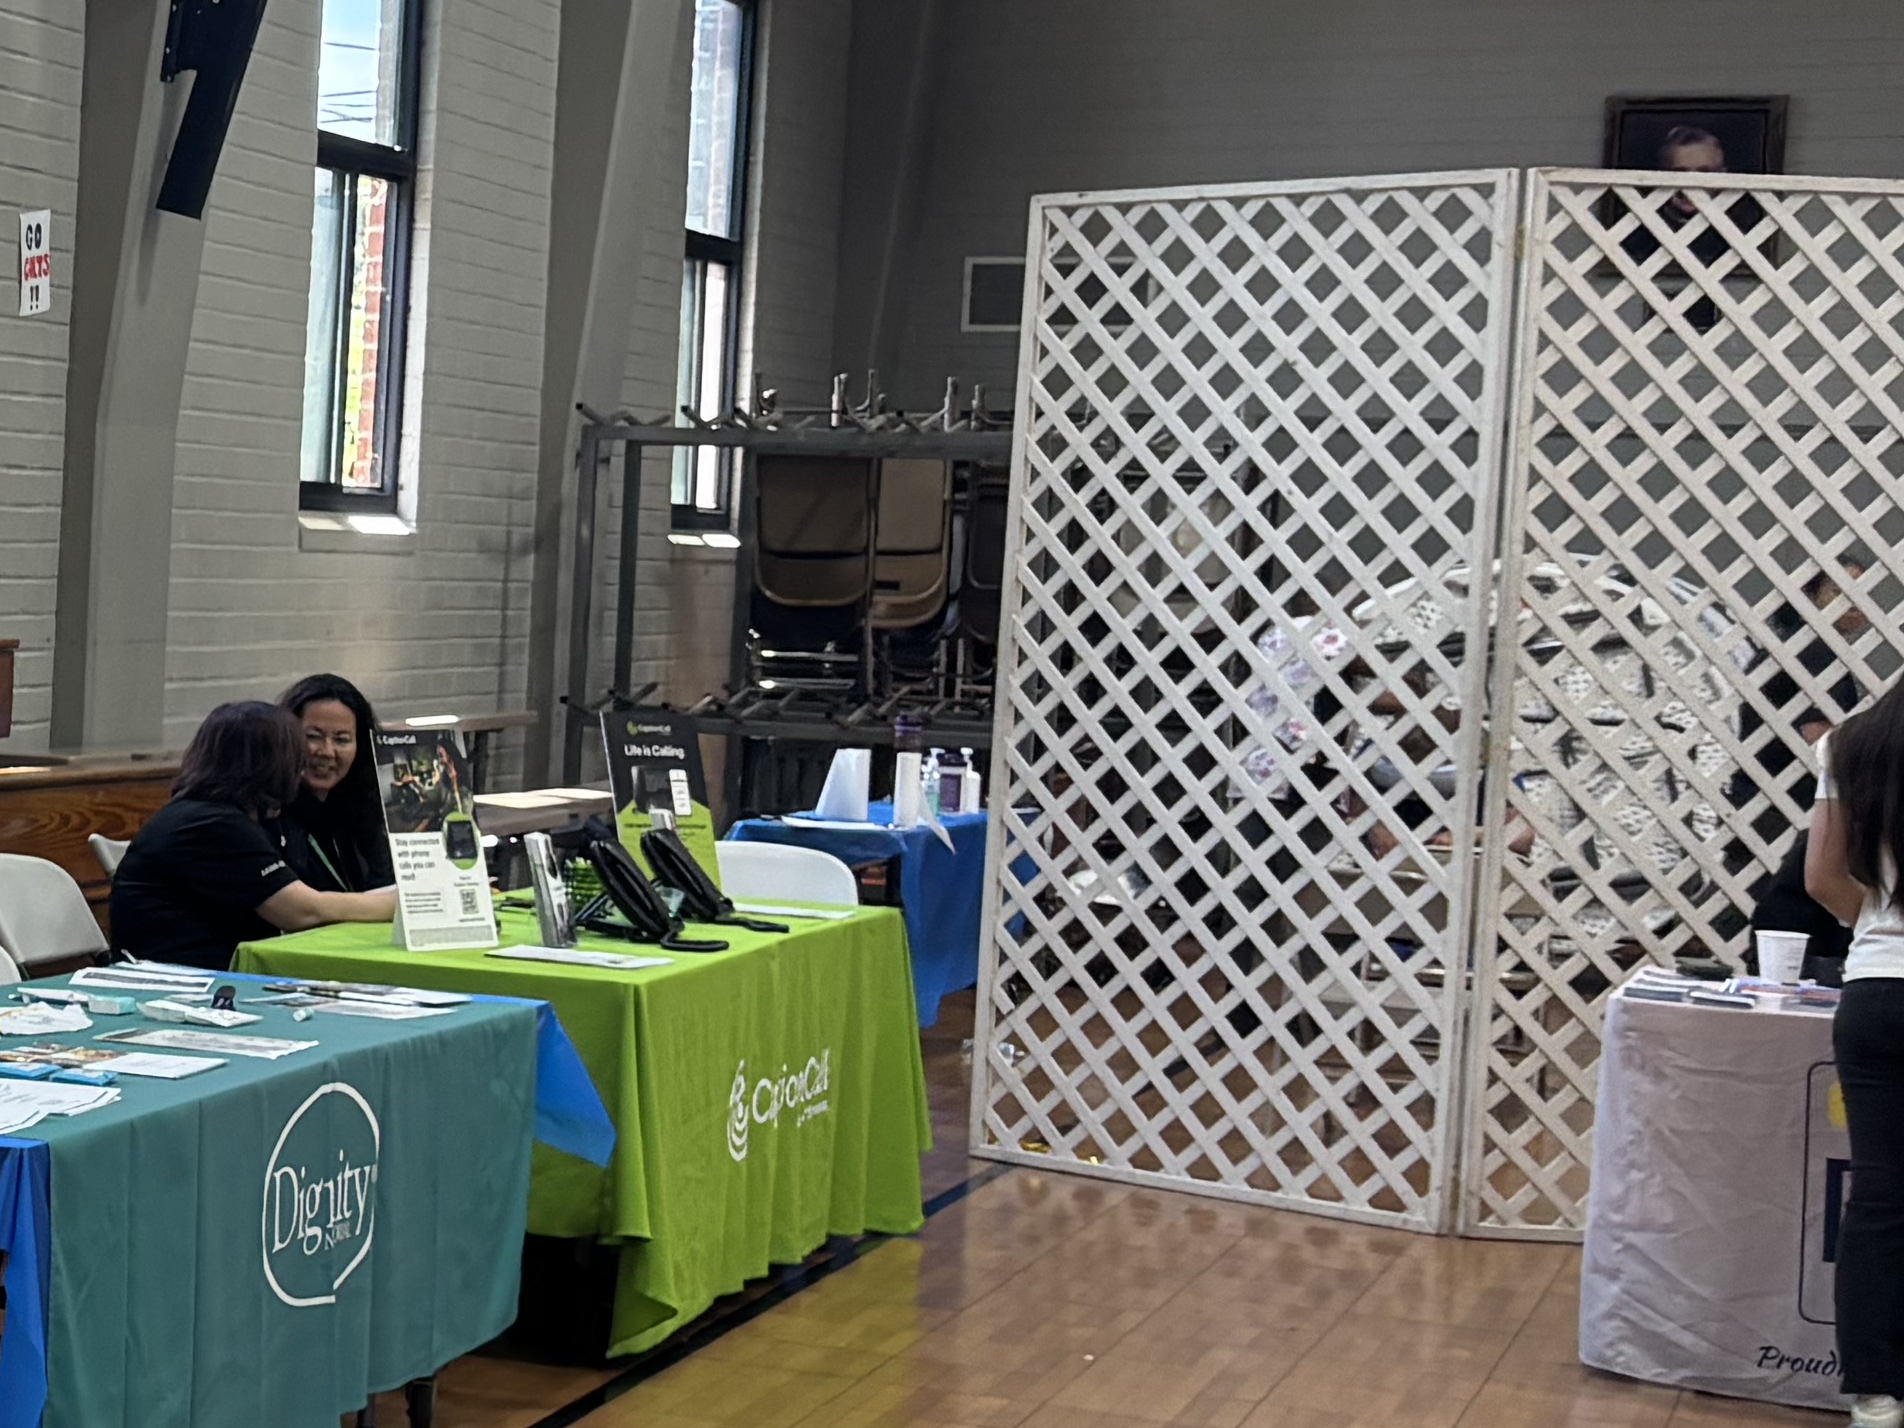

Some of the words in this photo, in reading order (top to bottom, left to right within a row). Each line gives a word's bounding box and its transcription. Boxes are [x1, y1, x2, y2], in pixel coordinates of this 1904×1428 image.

[25, 222, 42, 250] GO
[652, 745, 685, 759] Calling
[272, 1149, 371, 1255] Dignity
[1758, 1346, 1843, 1377] Proud
